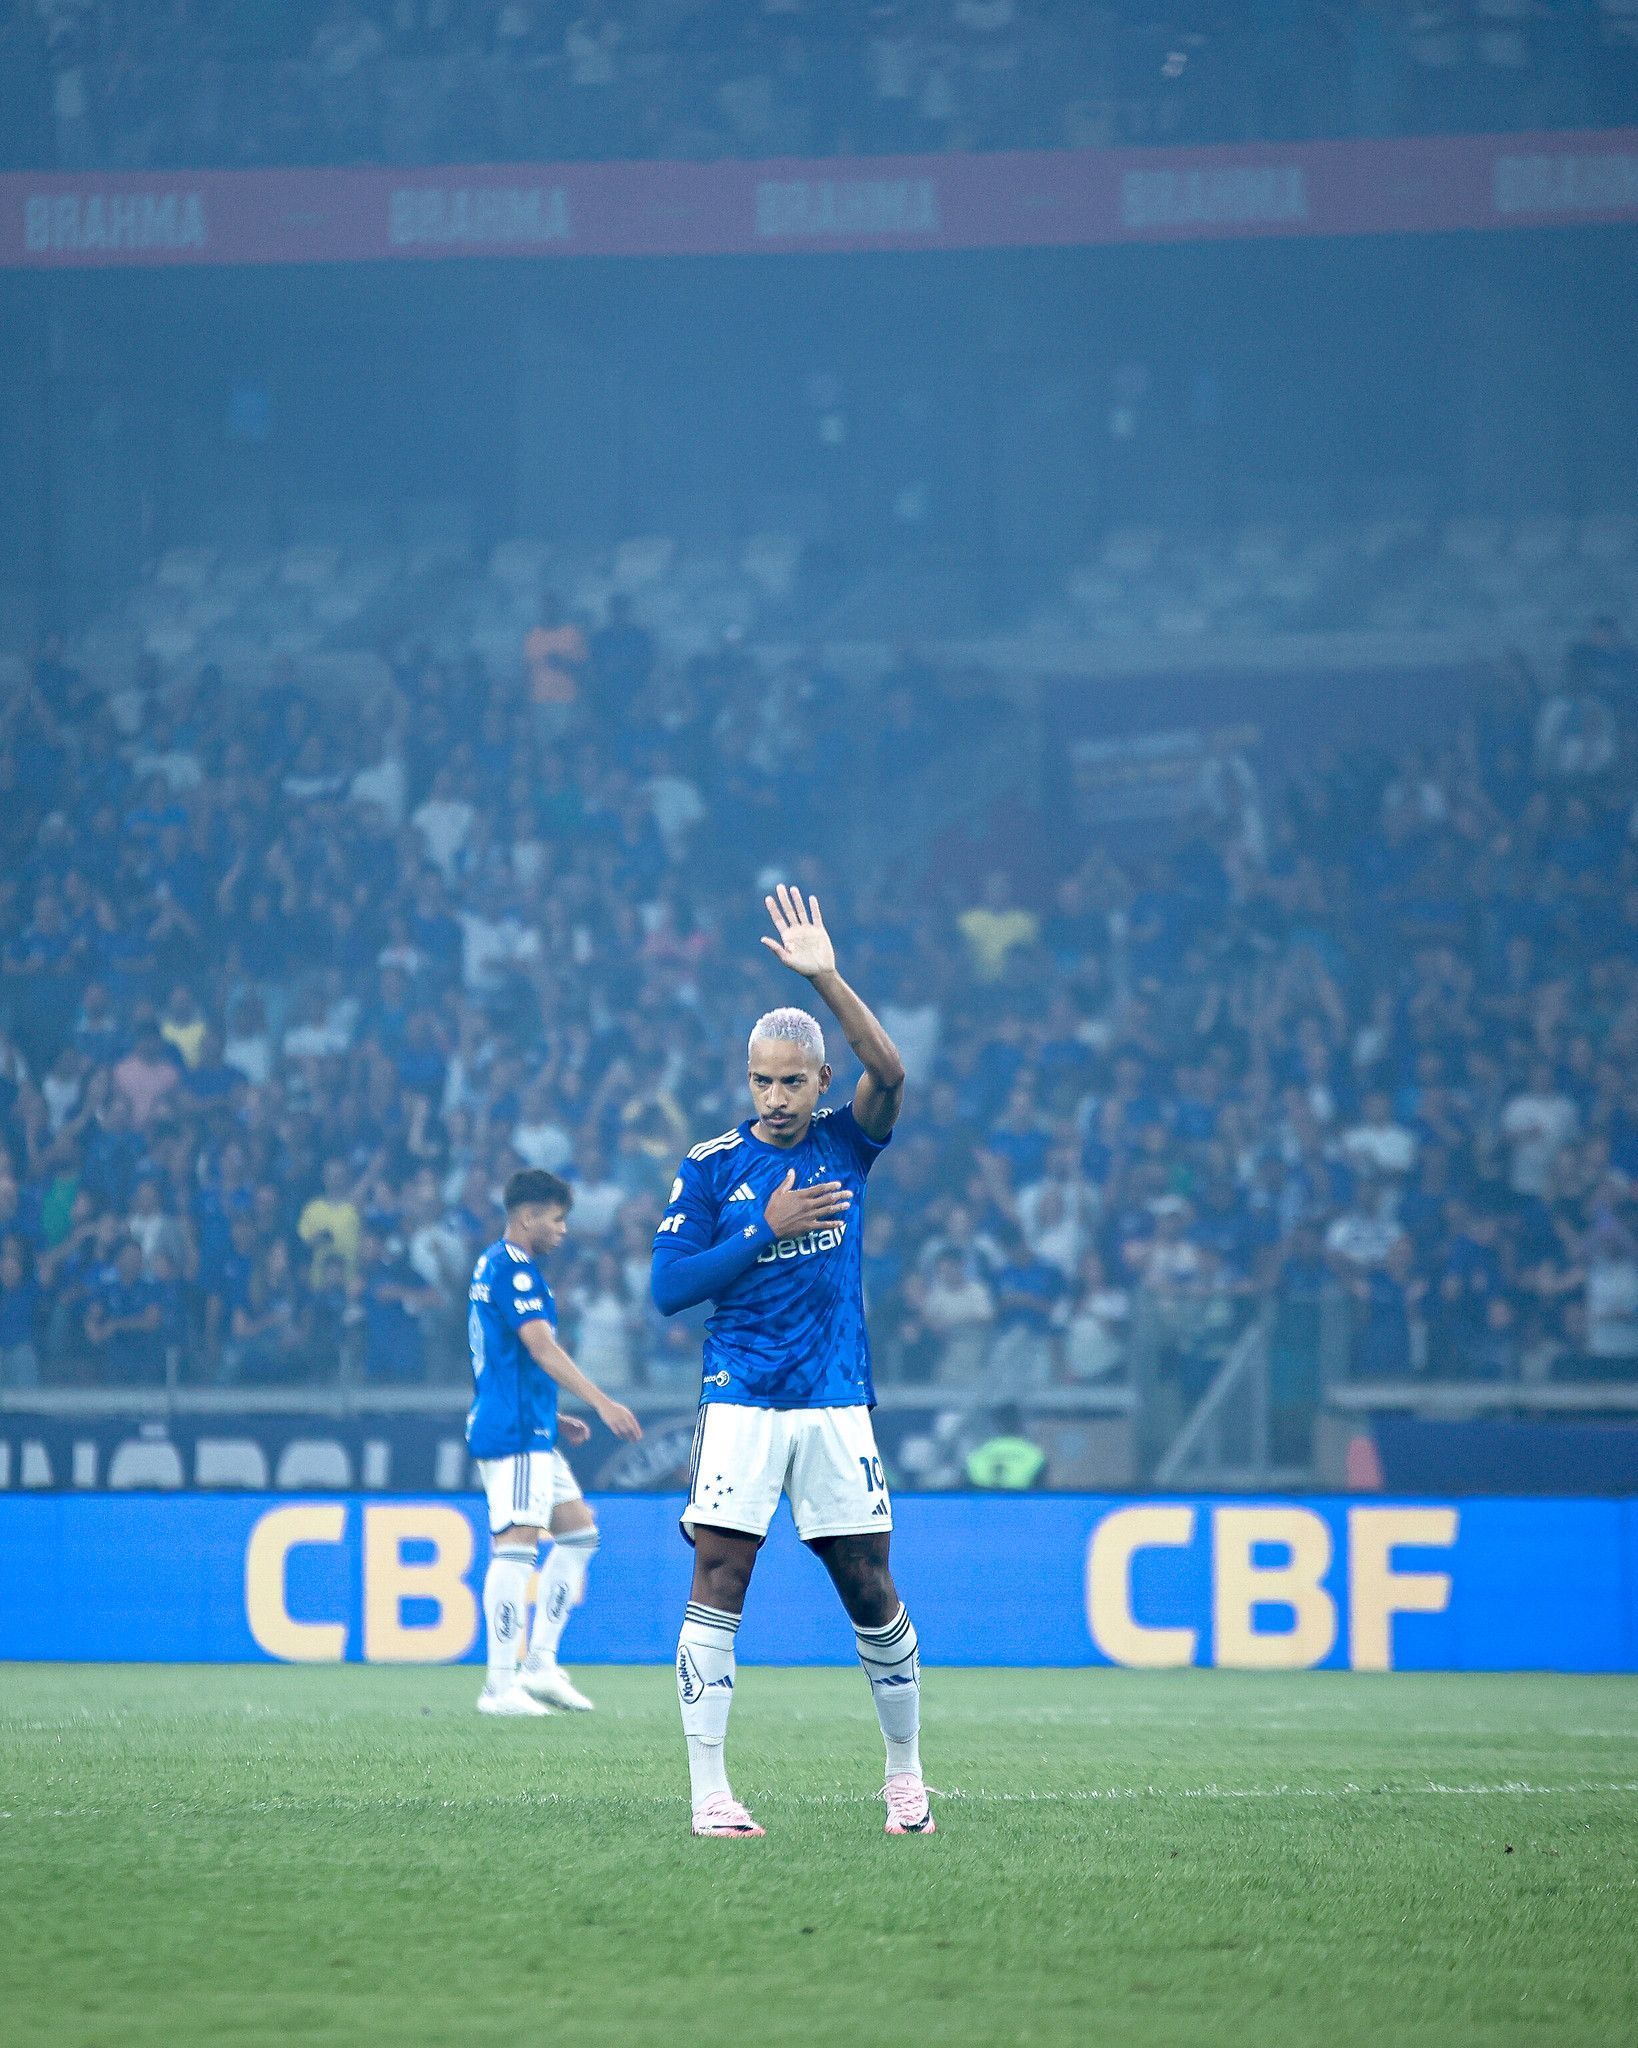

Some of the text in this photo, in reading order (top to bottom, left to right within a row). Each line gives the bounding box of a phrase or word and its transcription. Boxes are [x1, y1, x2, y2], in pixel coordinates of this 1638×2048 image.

[26, 193, 206, 250] BRAHMA
[859, 1456, 885, 1492] 10
[245, 1505, 583, 1661] CB
[1087, 1506, 1458, 1671] CBF
